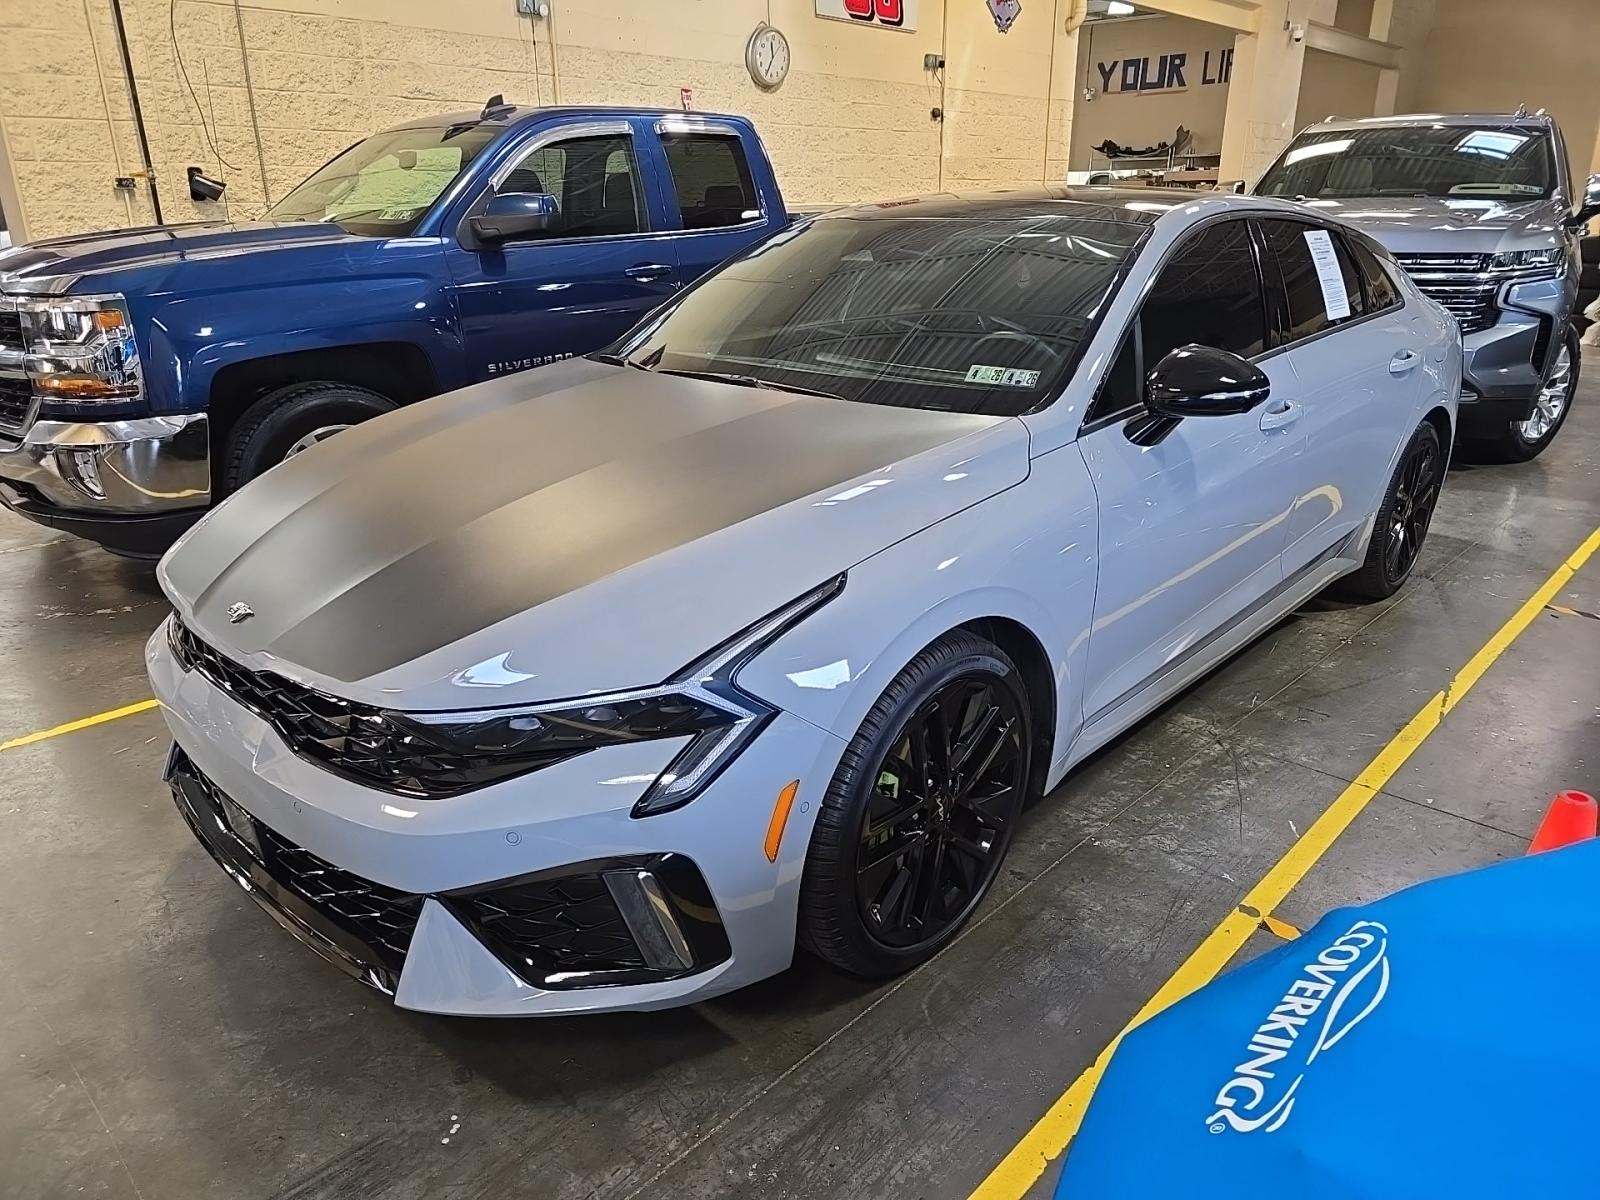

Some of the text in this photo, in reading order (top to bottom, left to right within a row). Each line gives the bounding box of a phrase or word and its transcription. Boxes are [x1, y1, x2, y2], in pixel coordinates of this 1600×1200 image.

[1097, 53, 1187, 93] YOUR
[971, 369, 1003, 382] 4 26
[1007, 372, 1038, 386] 4 26
[1215, 932, 1375, 1111] COVERKING
